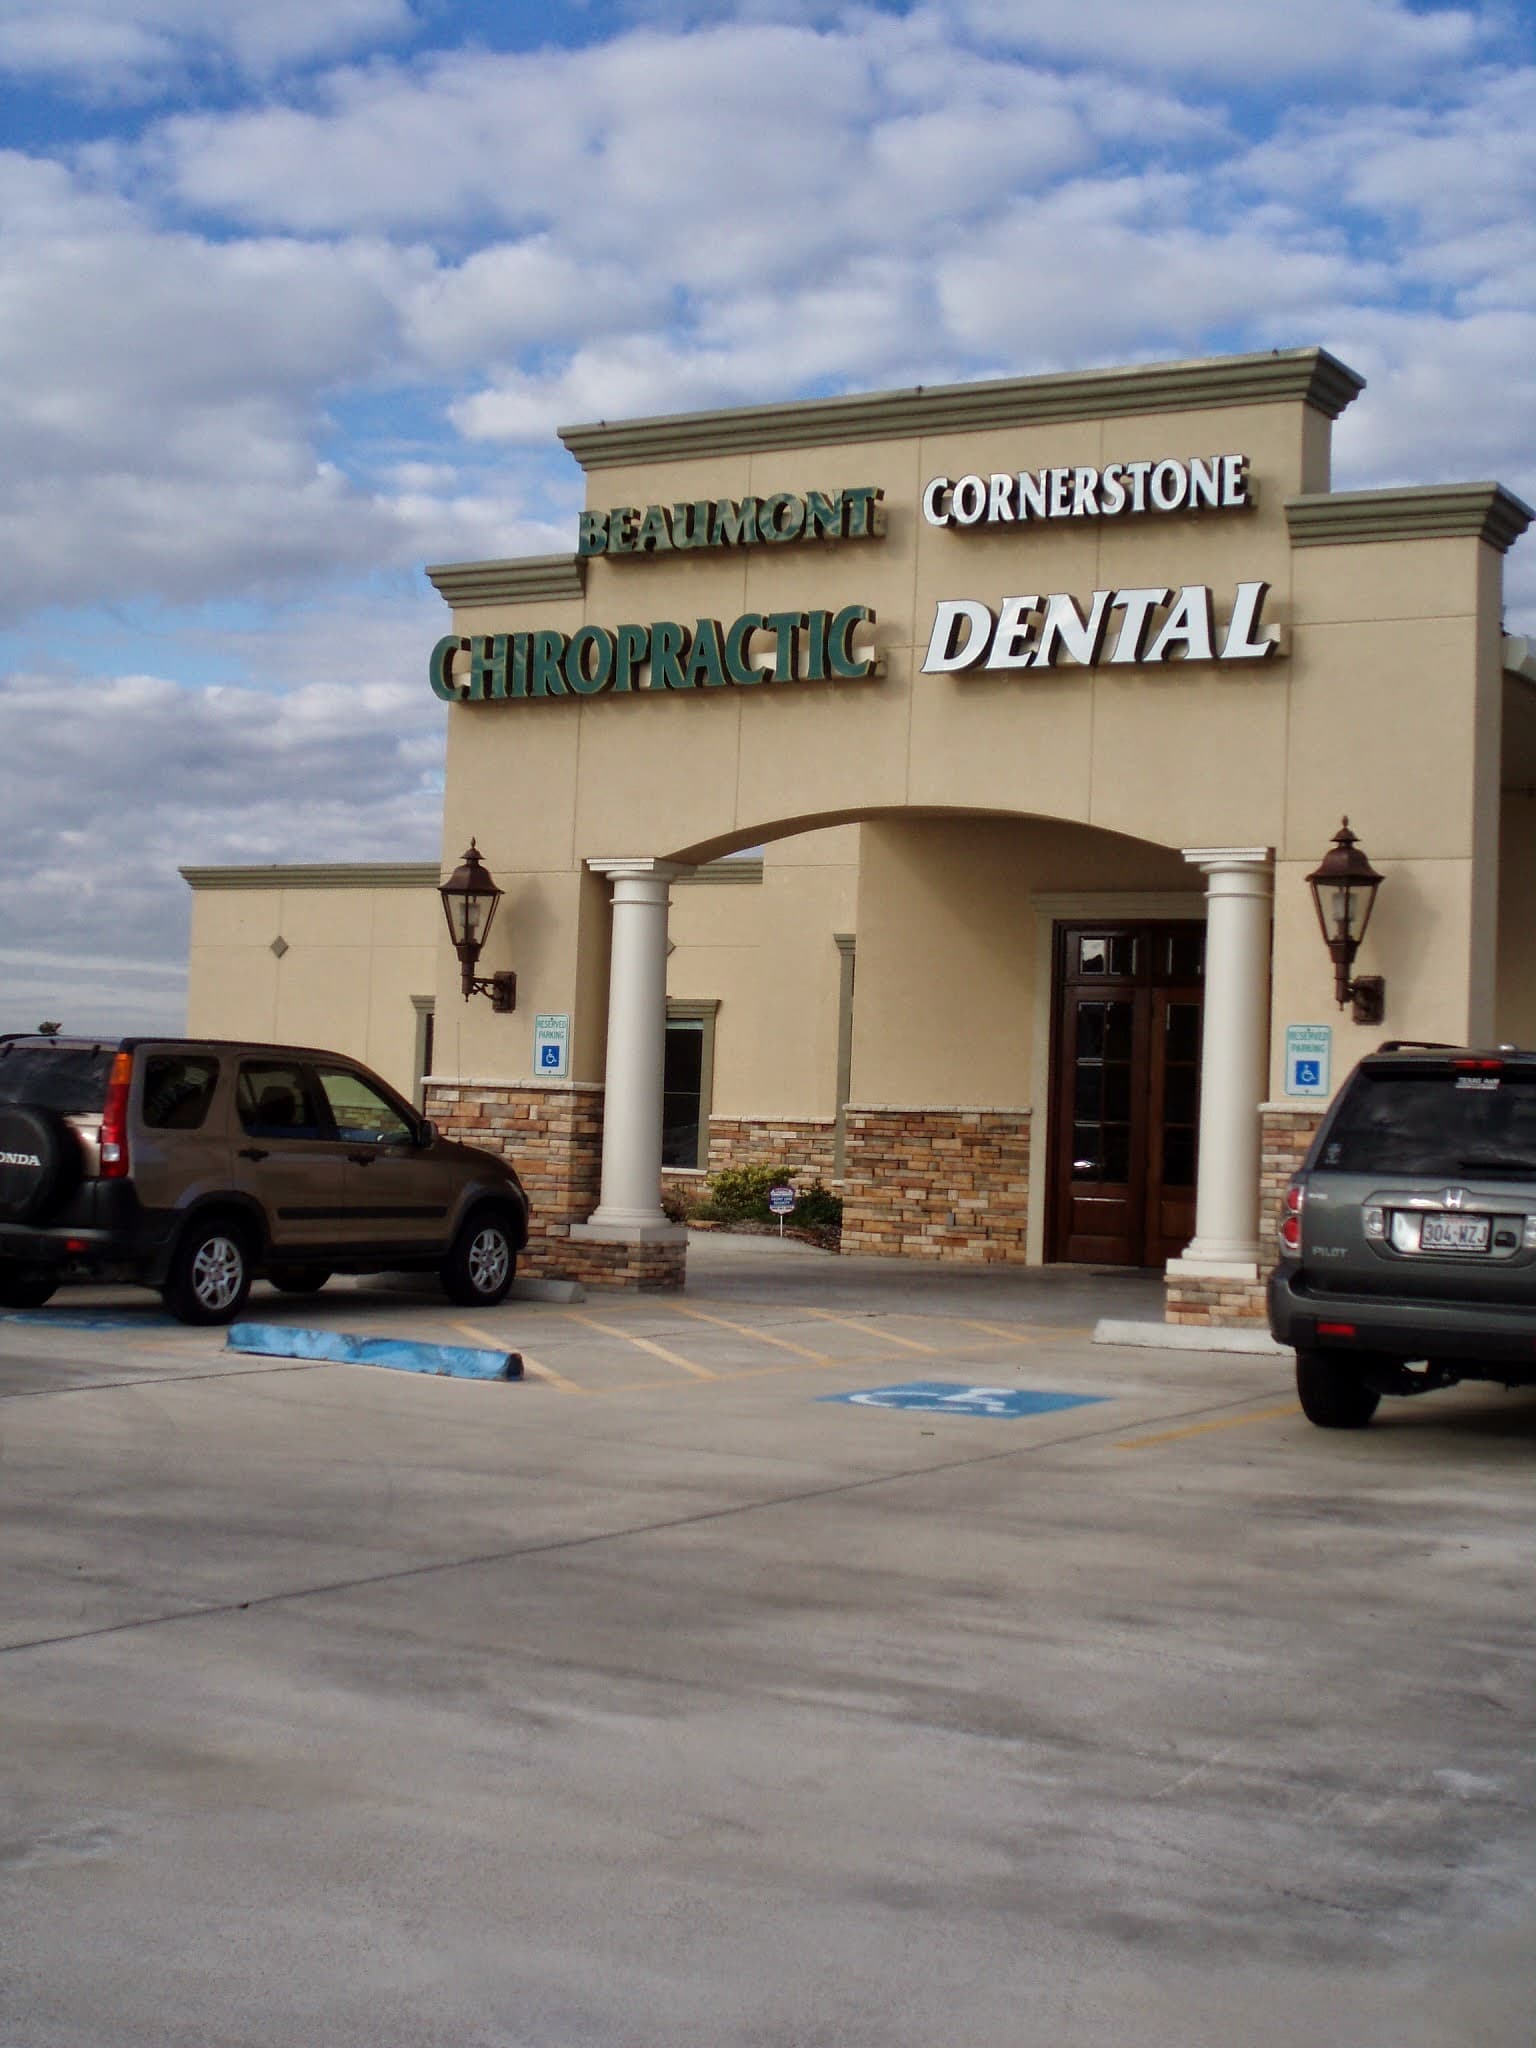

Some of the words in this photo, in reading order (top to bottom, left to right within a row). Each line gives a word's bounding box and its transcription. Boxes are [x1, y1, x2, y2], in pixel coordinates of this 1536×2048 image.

[578, 486, 885, 557] BEAUMONT
[922, 453, 1250, 527] CORNERSTONE
[429, 604, 878, 701] CHIROPRACTIC
[920, 581, 1276, 674] DENTAL
[0, 1151, 41, 1167] ONDA
[1312, 1246, 1349, 1258] PILOT
